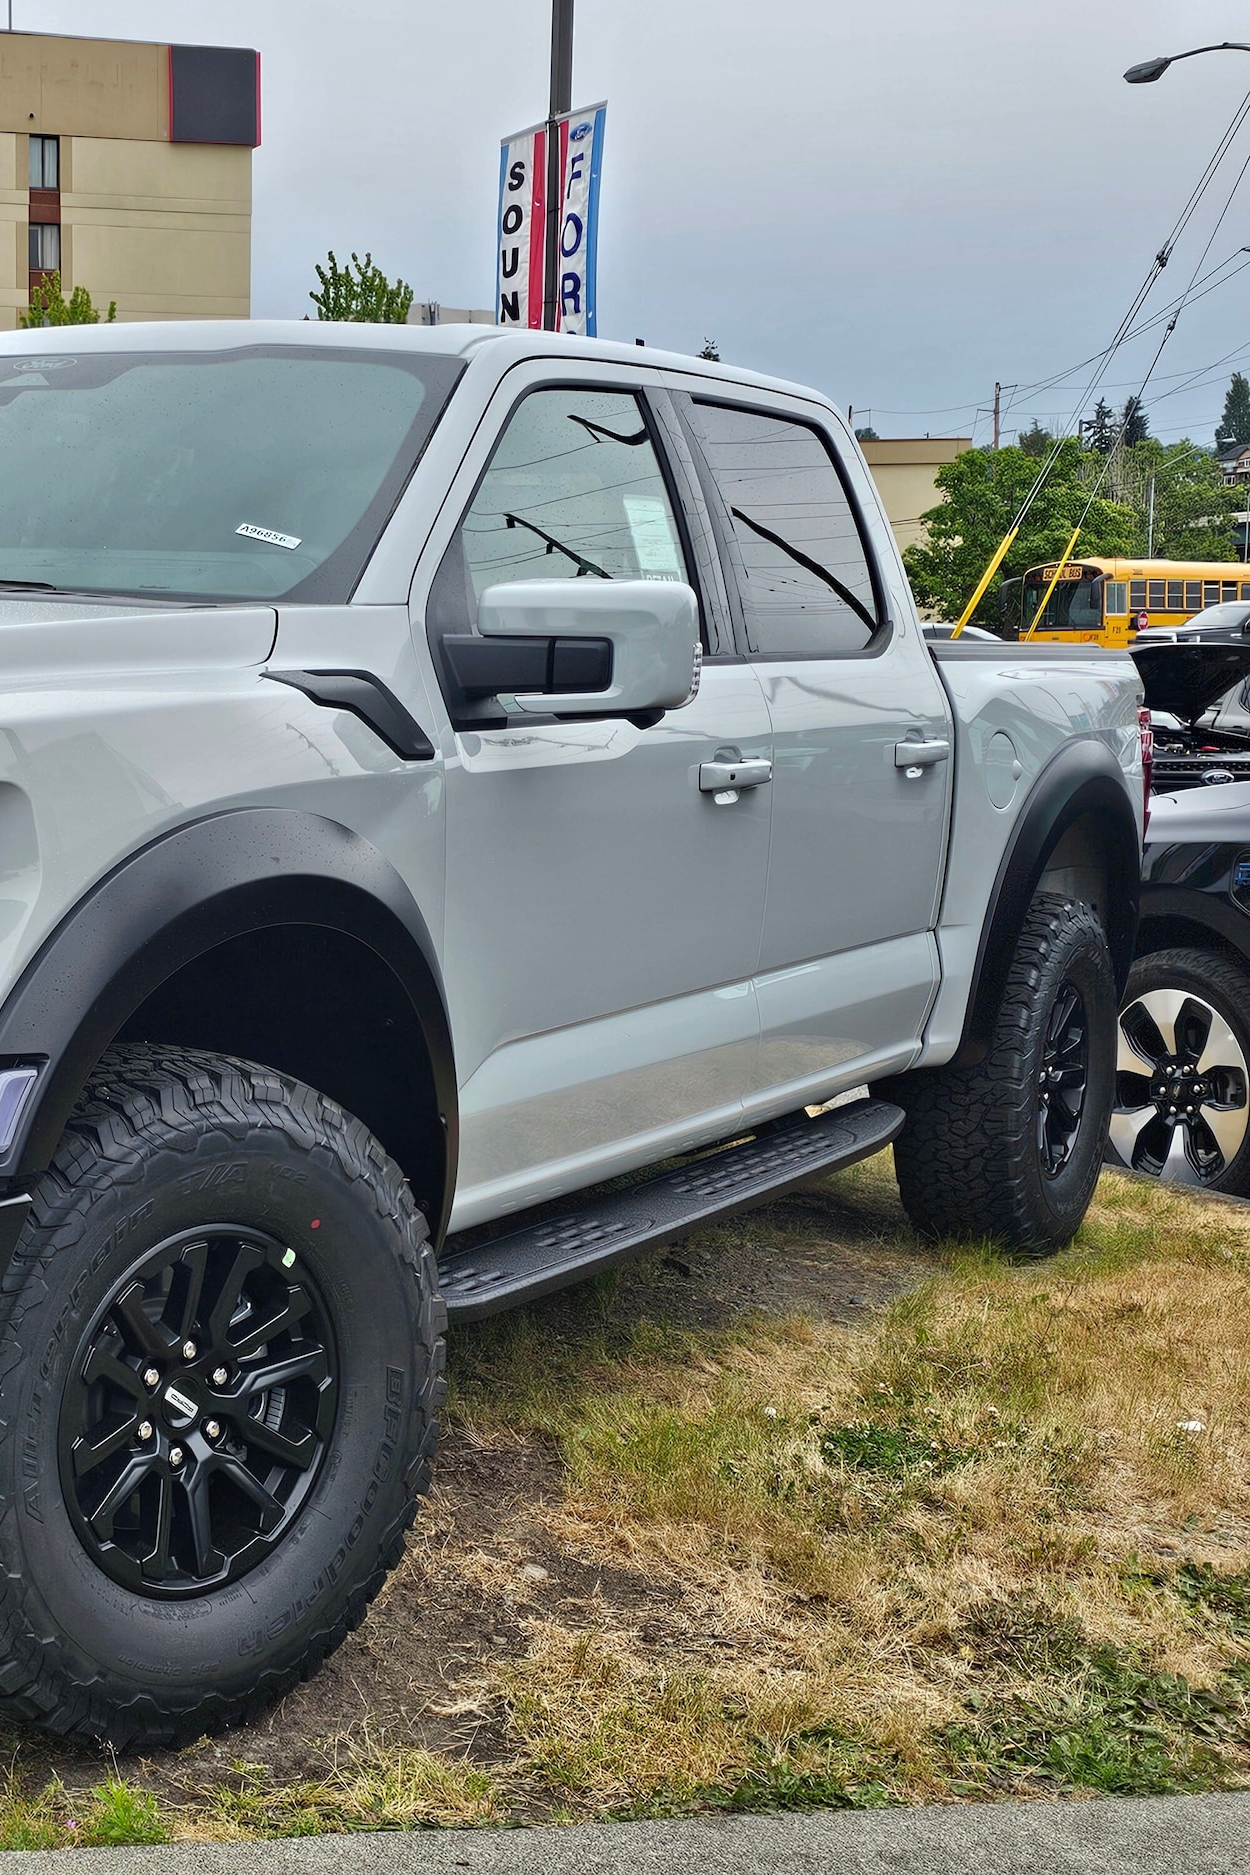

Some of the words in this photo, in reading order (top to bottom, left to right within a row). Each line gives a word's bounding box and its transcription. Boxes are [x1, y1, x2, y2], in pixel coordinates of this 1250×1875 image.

[561, 152, 584, 335] FOR
[1044, 569, 1067, 580] SCHOL
[1069, 567, 1081, 578] BUS
